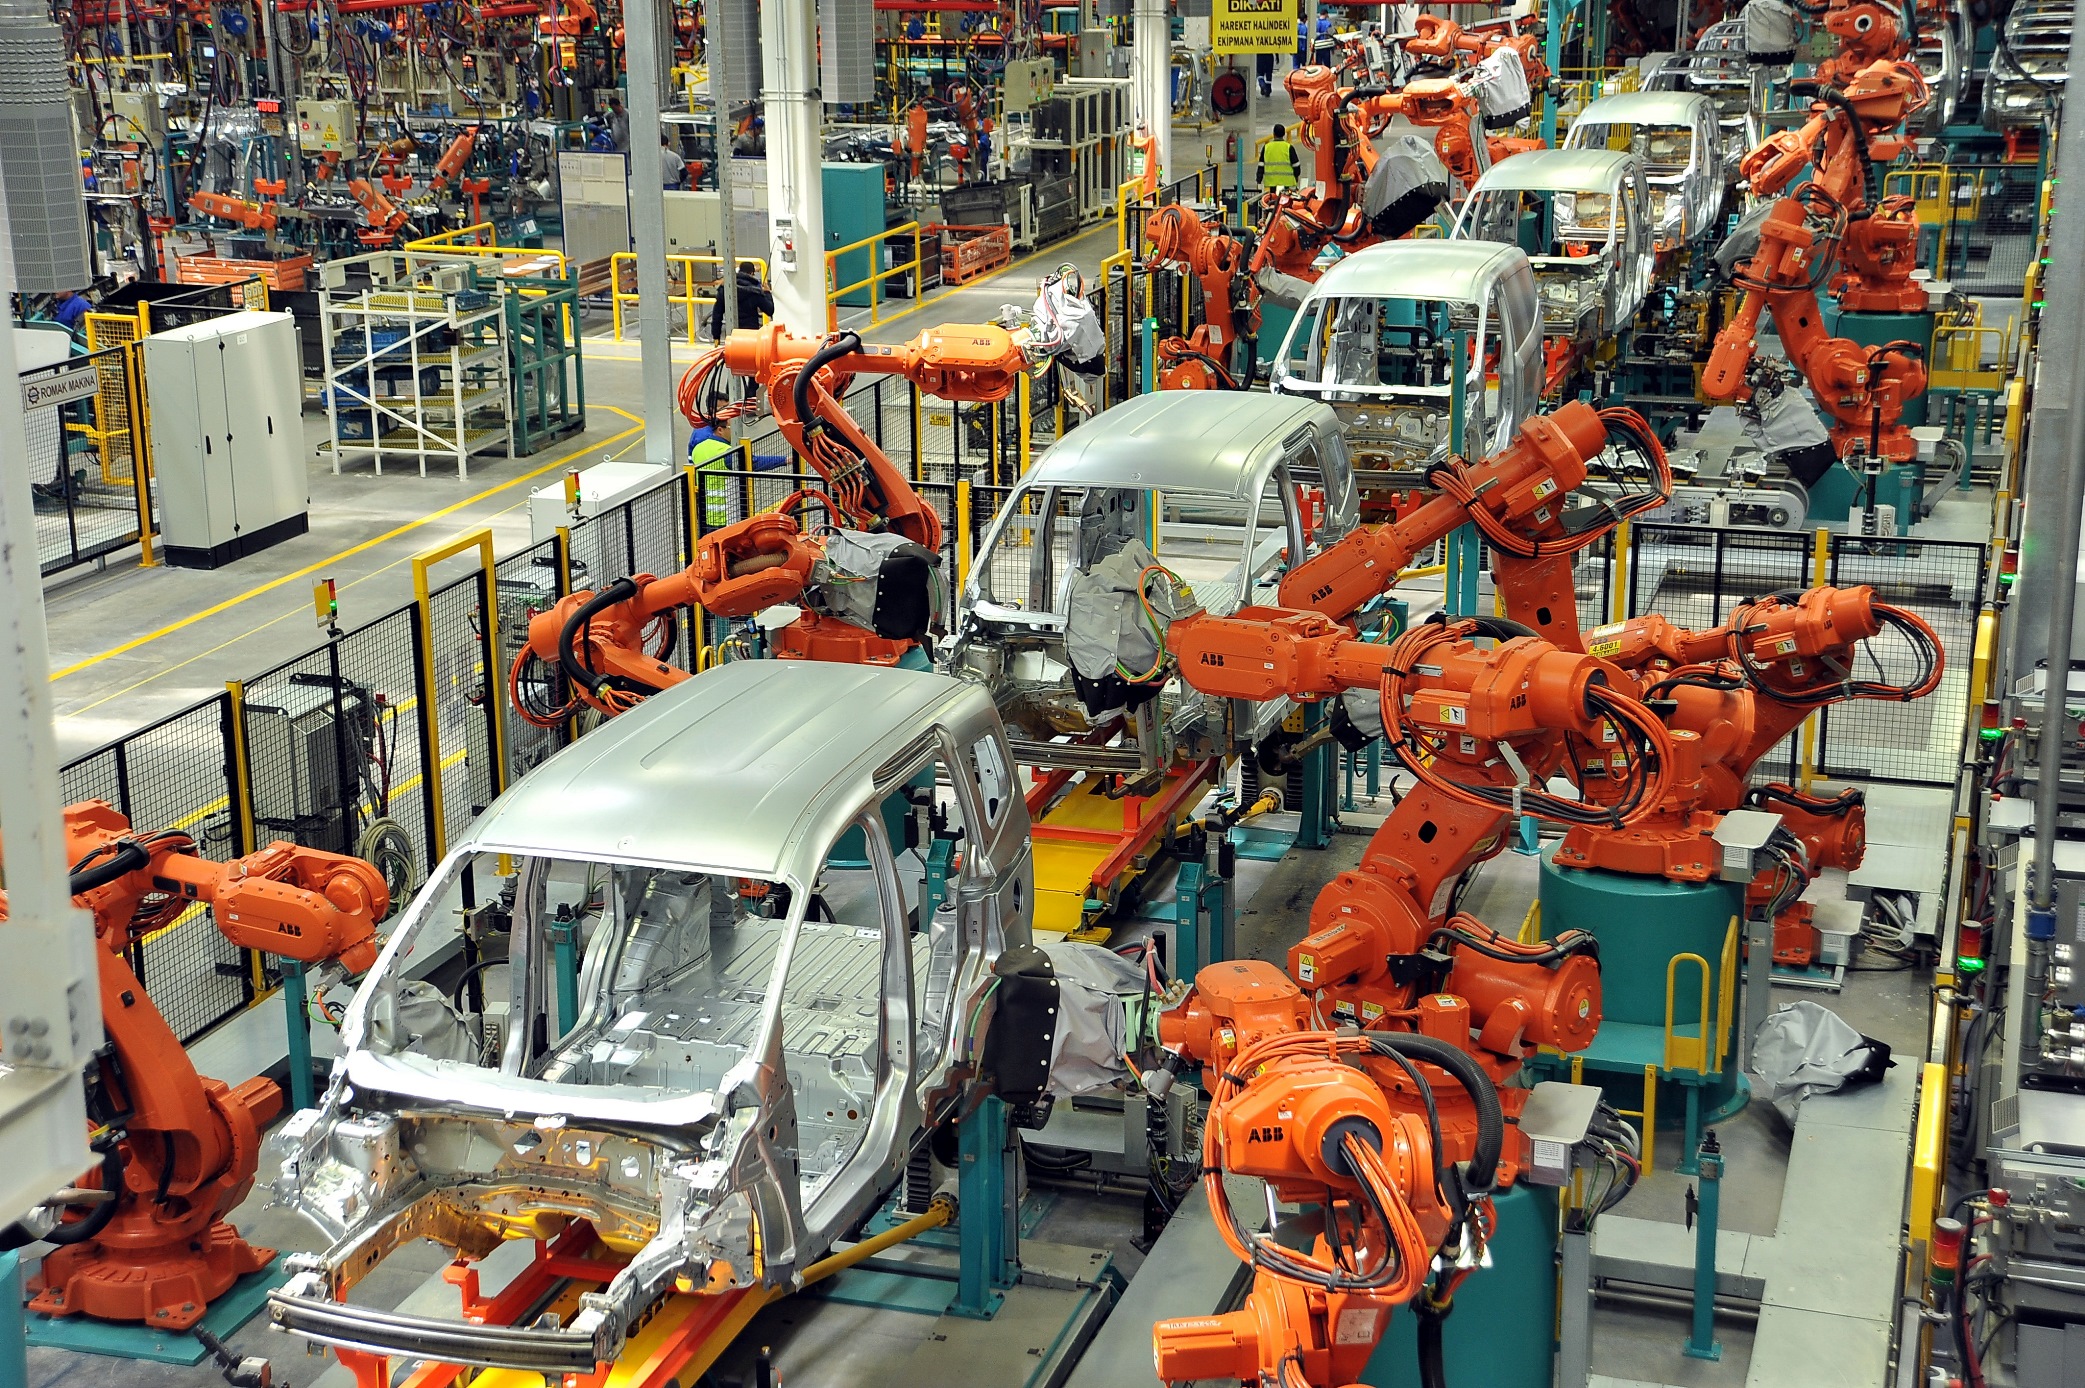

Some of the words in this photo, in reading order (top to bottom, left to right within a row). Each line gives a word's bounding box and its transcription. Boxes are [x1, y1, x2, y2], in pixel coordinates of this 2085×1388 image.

[1220, 20, 1251, 31] HAREKET
[1253, 18, 1290, 30] HALİNDEKİ
[1217, 34, 1254, 46] EKİPMANA
[1255, 36, 1293, 48] YAKLAŞMA
[40, 382, 68, 399] ROMAK
[1311, 584, 1334, 605] ABB
[1200, 652, 1225, 667] ABB
[1510, 693, 1527, 711] ABB
[278, 922, 302, 937] ABB
[1248, 1126, 1284, 1144] ABB
